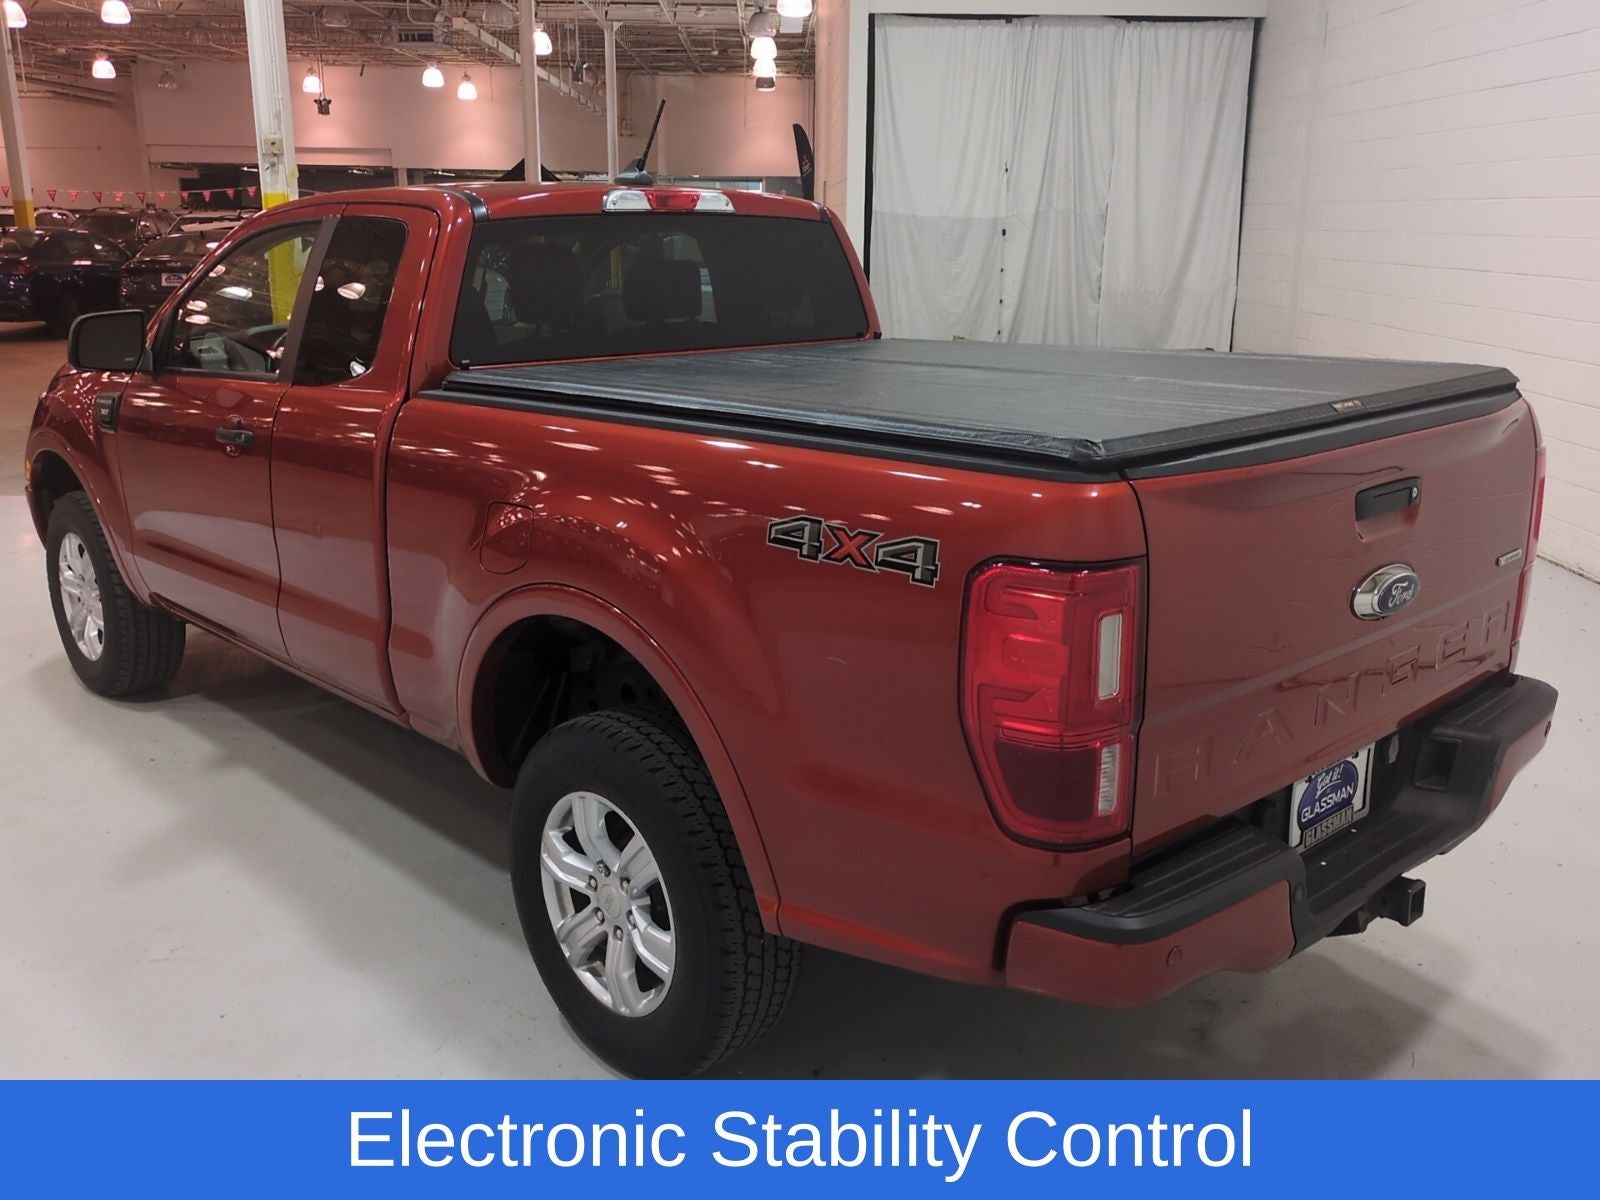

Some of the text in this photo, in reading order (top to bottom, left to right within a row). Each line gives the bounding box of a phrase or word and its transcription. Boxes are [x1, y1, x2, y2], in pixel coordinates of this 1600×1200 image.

[1389, 581, 1415, 607] Ford
[1152, 600, 1511, 799] RANGER
[1301, 782, 1354, 822] GLASSMAN
[1304, 805, 1353, 848] GLASSMAN
